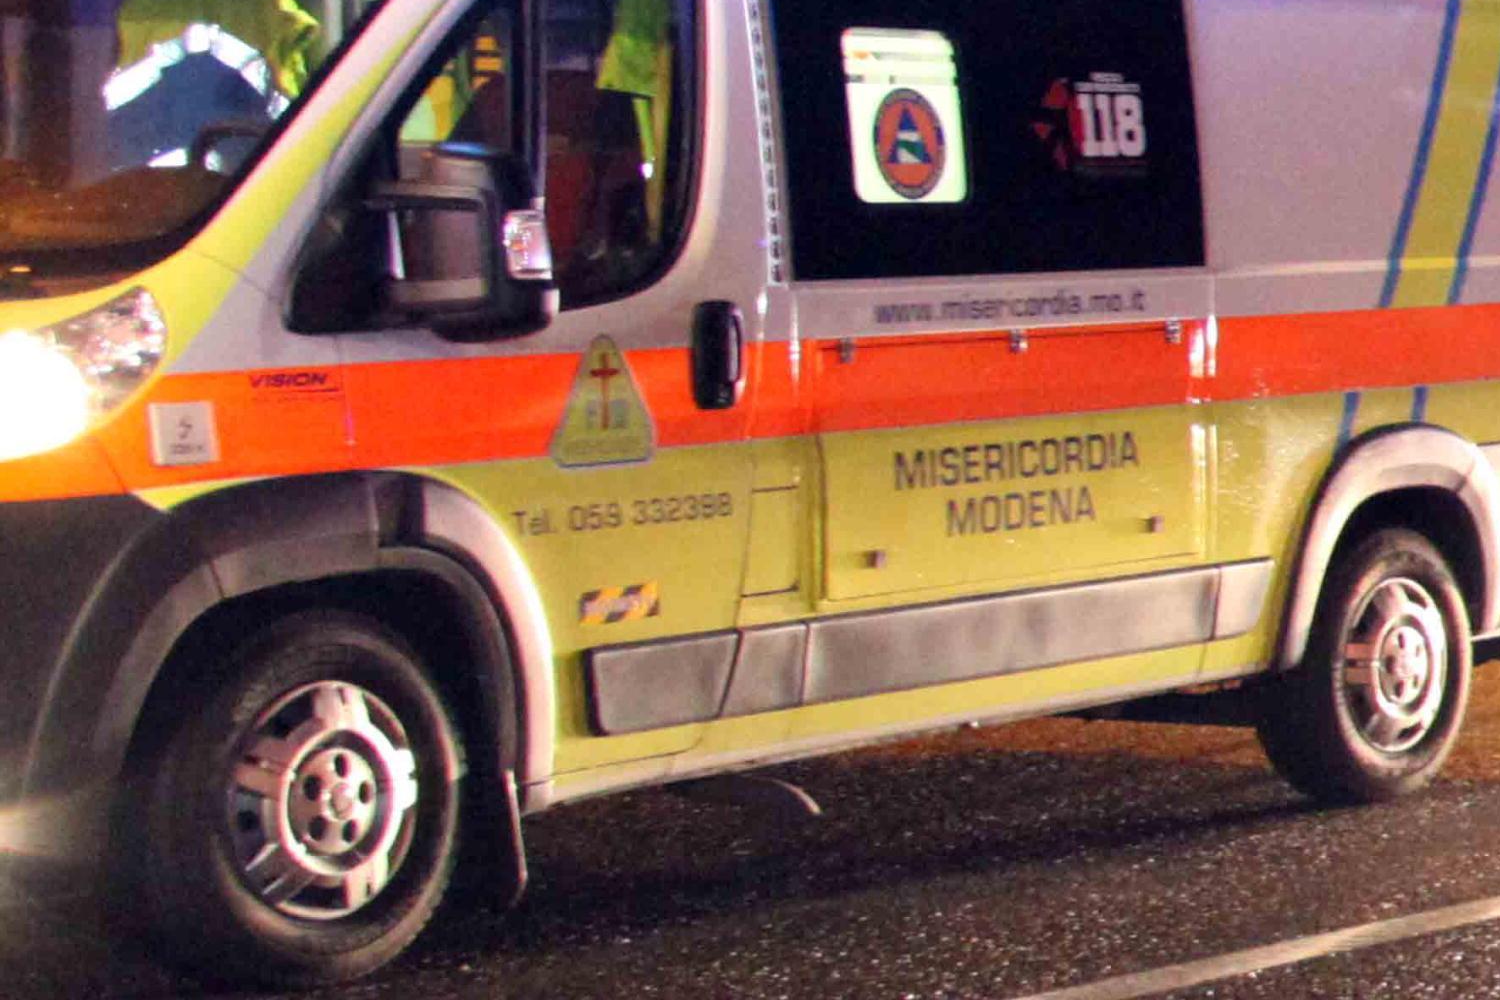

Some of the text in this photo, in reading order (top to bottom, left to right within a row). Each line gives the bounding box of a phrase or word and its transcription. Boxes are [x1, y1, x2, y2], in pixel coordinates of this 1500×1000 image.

[1076, 92, 1148, 158] 118
[249, 372, 329, 388] VISION
[893, 430, 1141, 491] MISERICORDIA
[567, 502, 622, 532] 059
[946, 485, 1097, 537] MODENA
